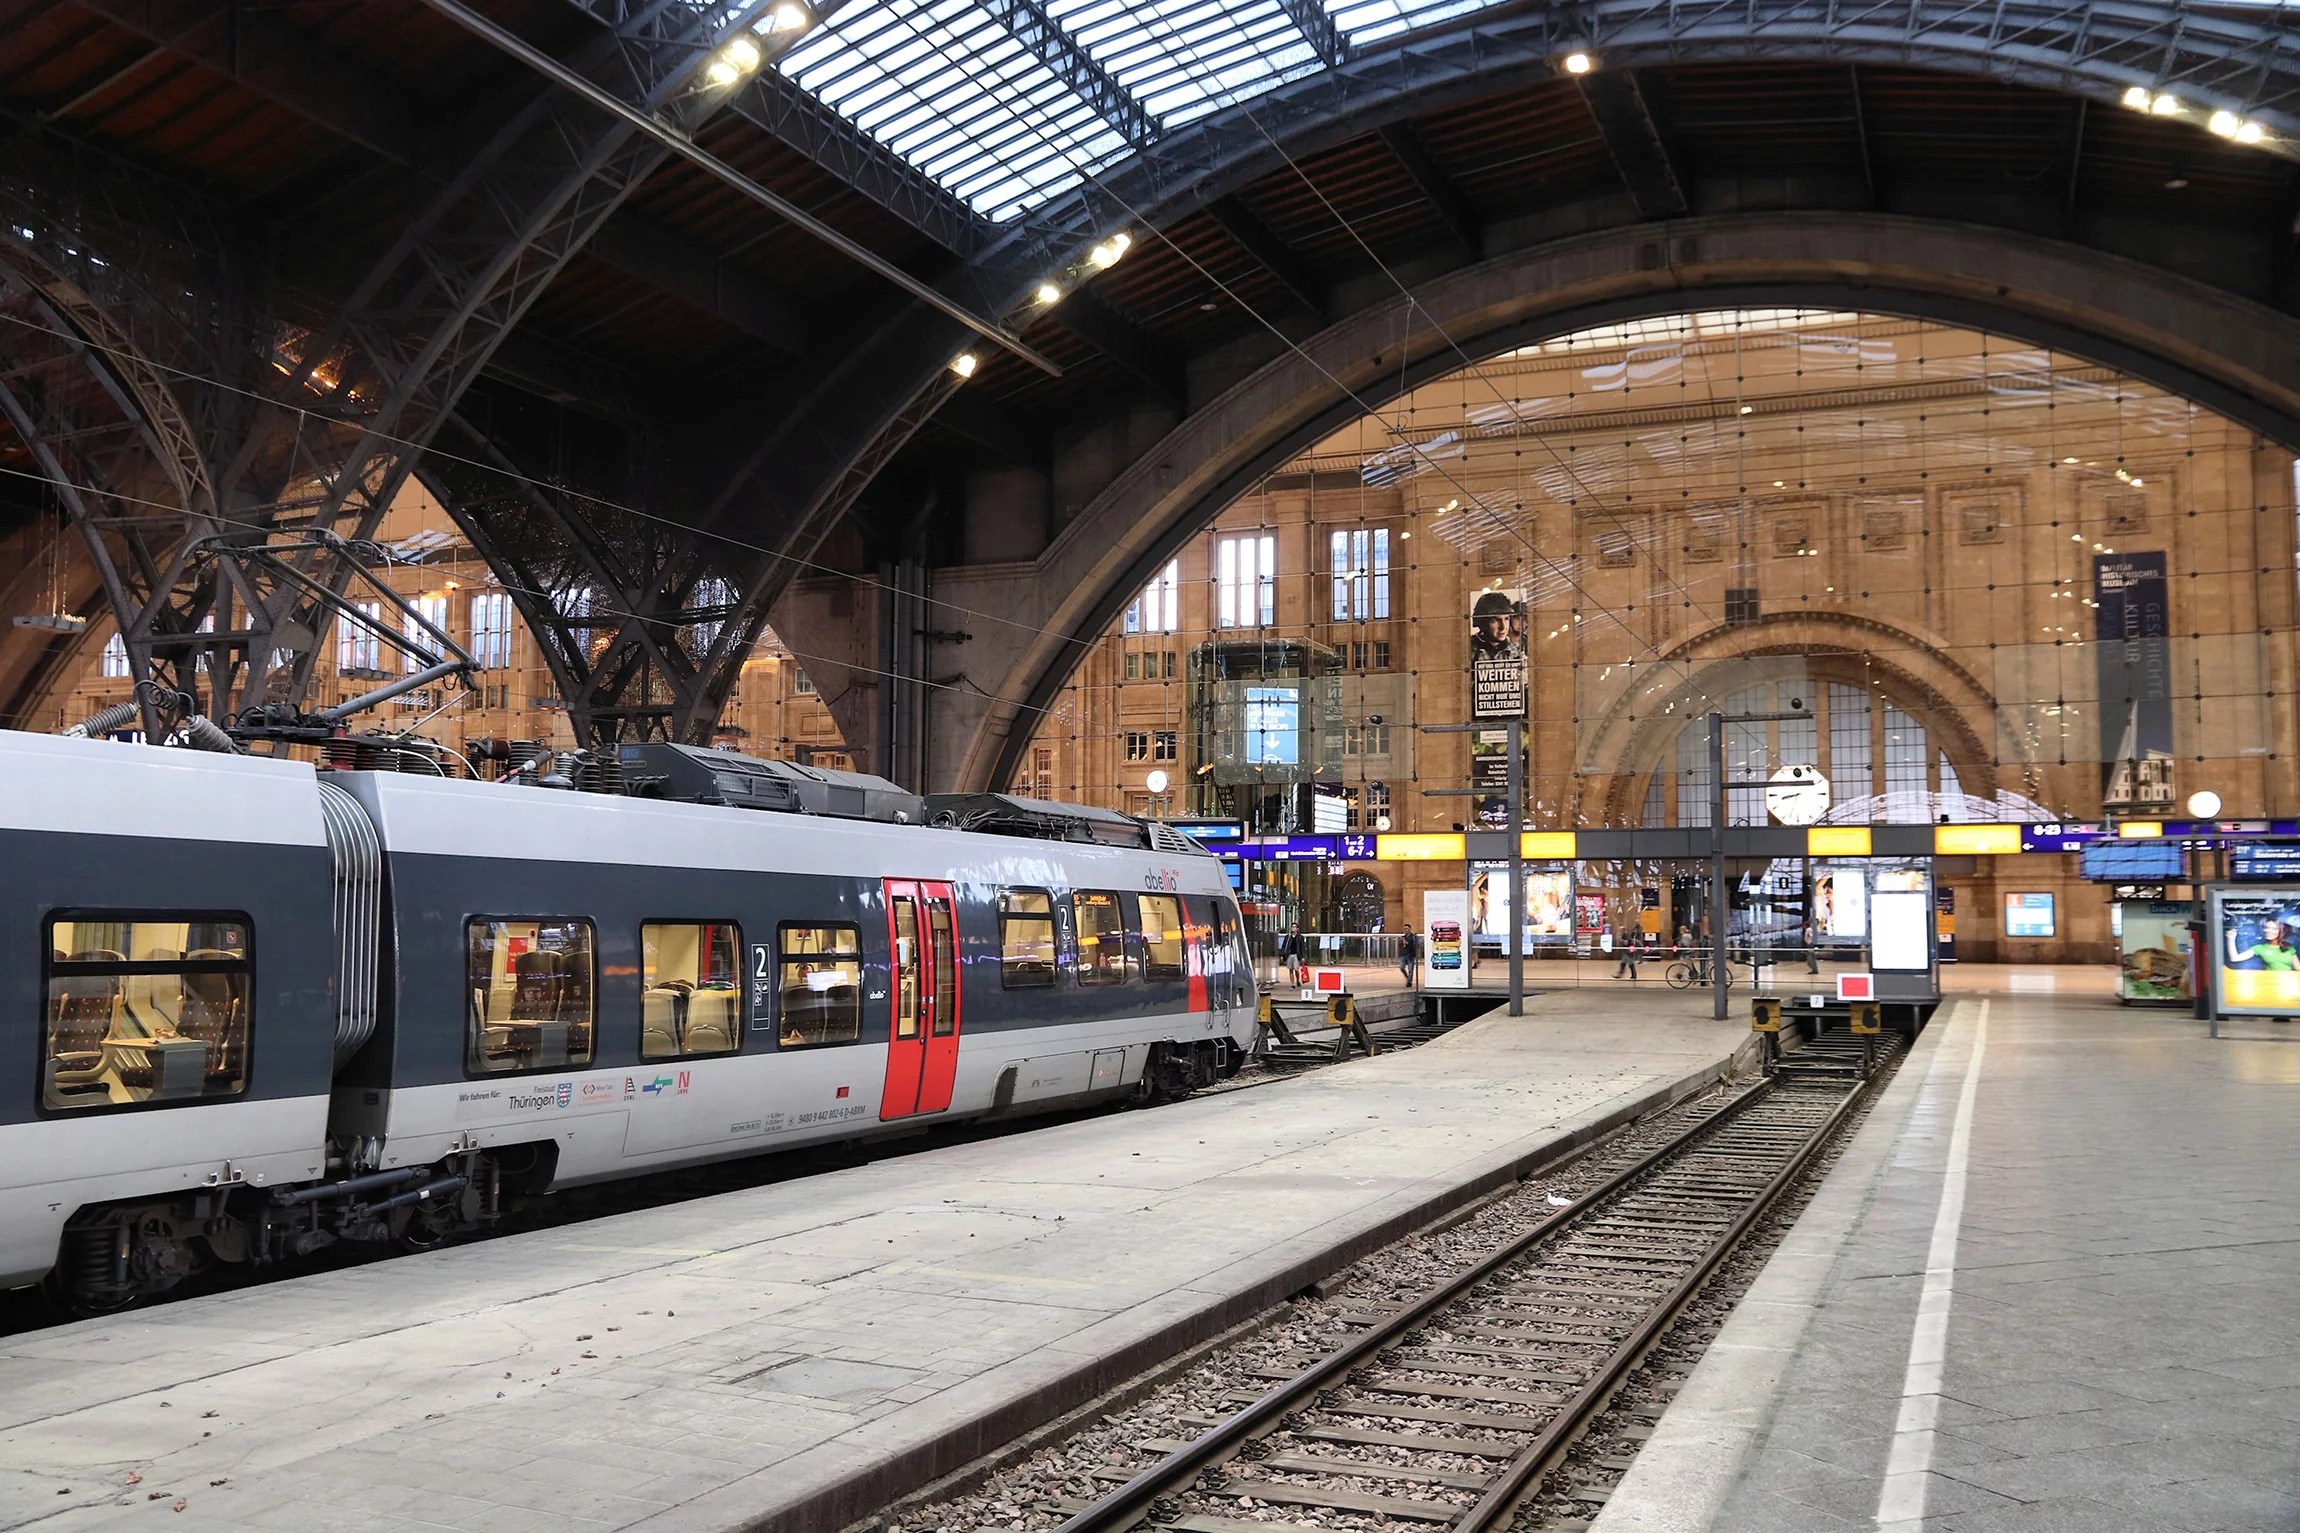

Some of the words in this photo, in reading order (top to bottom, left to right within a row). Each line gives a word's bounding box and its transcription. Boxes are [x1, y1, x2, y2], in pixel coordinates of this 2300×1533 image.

[2124, 604, 2141, 663] KULTUR
[2145, 602, 2164, 698] GESCHICHTE
[1478, 668, 1520, 681] WEITER-
[1478, 681, 1520, 693] KOMMEN
[1478, 700, 1520, 709] STILLSTEHEN
[2033, 824, 2061, 836] 8-23
[1344, 836, 1350, 845] 1
[1357, 836, 1365, 845] 2
[1348, 846, 1364, 857] 6-7
[1145, 867, 1177, 891] abellio
[1060, 907, 1069, 930] 2
[755, 947, 767, 977] 2
[869, 991, 885, 1000] abellio
[459, 1094, 470, 1102] Wir
[470, 1092, 489, 1100] fahren
[509, 1095, 555, 1110] Thüringen
